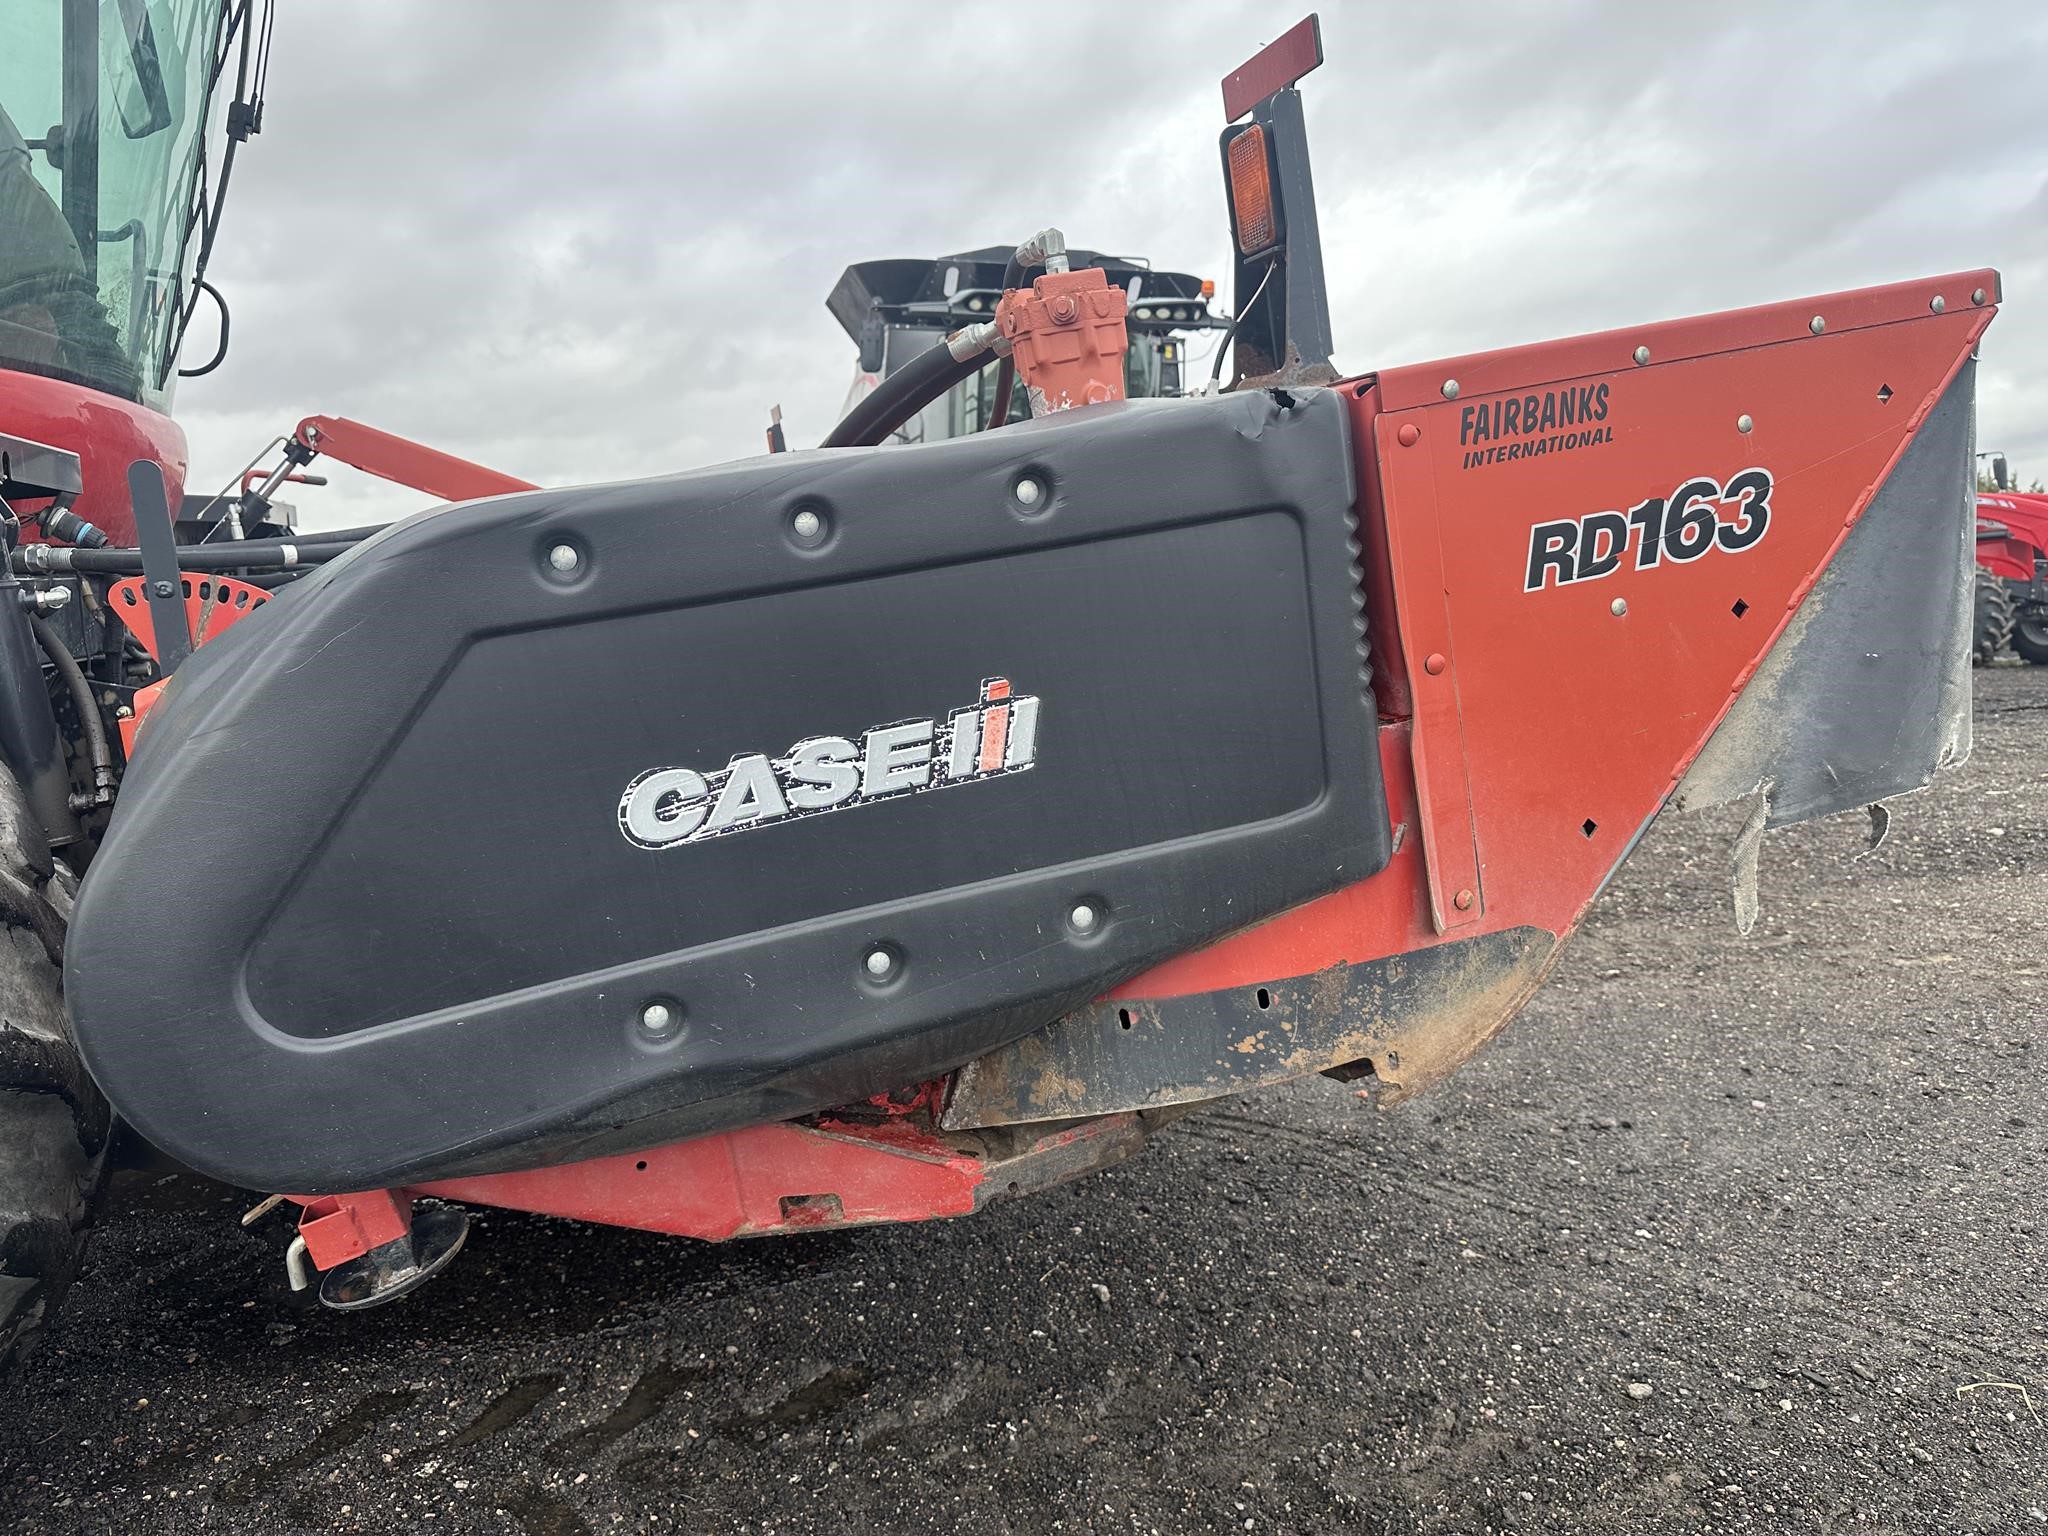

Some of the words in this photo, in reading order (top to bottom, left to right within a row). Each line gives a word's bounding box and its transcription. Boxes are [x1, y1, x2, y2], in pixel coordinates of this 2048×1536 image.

[1461, 383, 1609, 446] FAIRBANKS
[1462, 426, 1614, 469] INTERNATIONAL
[1523, 467, 1774, 593] RD163
[617, 717, 934, 850] CASE
